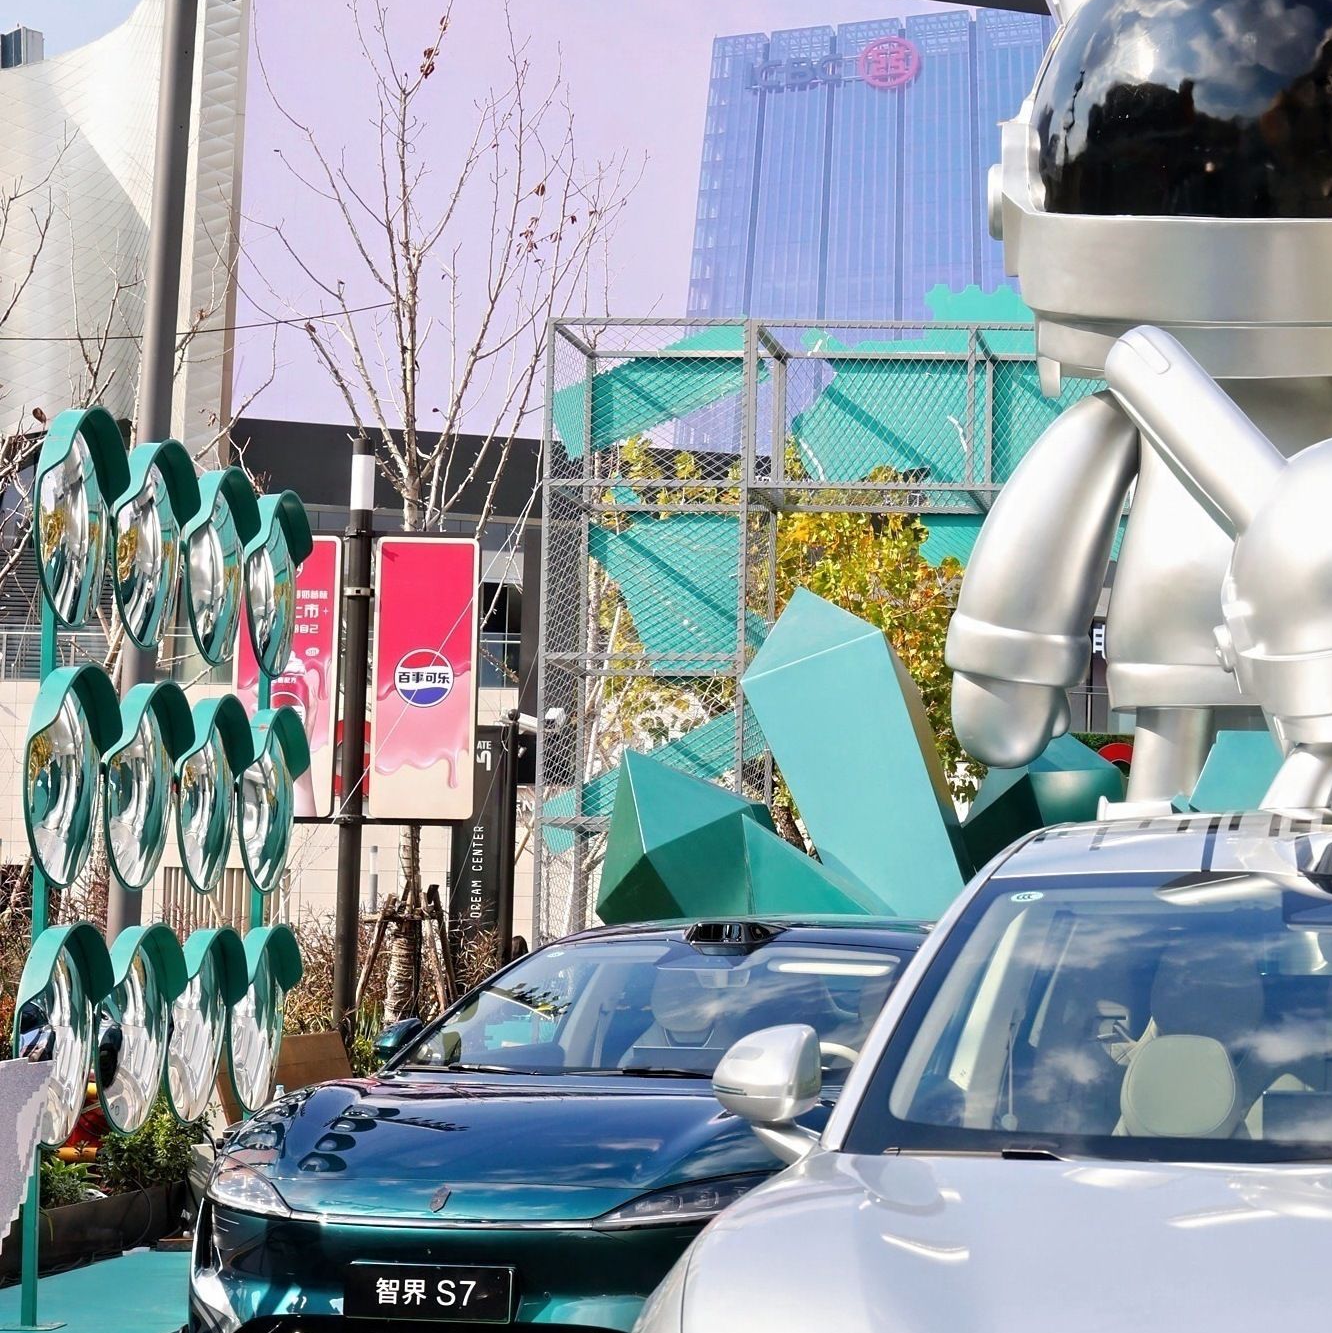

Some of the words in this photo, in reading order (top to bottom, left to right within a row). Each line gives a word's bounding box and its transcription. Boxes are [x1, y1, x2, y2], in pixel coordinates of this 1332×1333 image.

[398, 672, 450, 684] 百事可乐
[472, 826, 484, 872] CENTER
[470, 880, 482, 918] DREAM
[375, 1277, 427, 1306] 智界
[436, 1279, 477, 1307] S7
